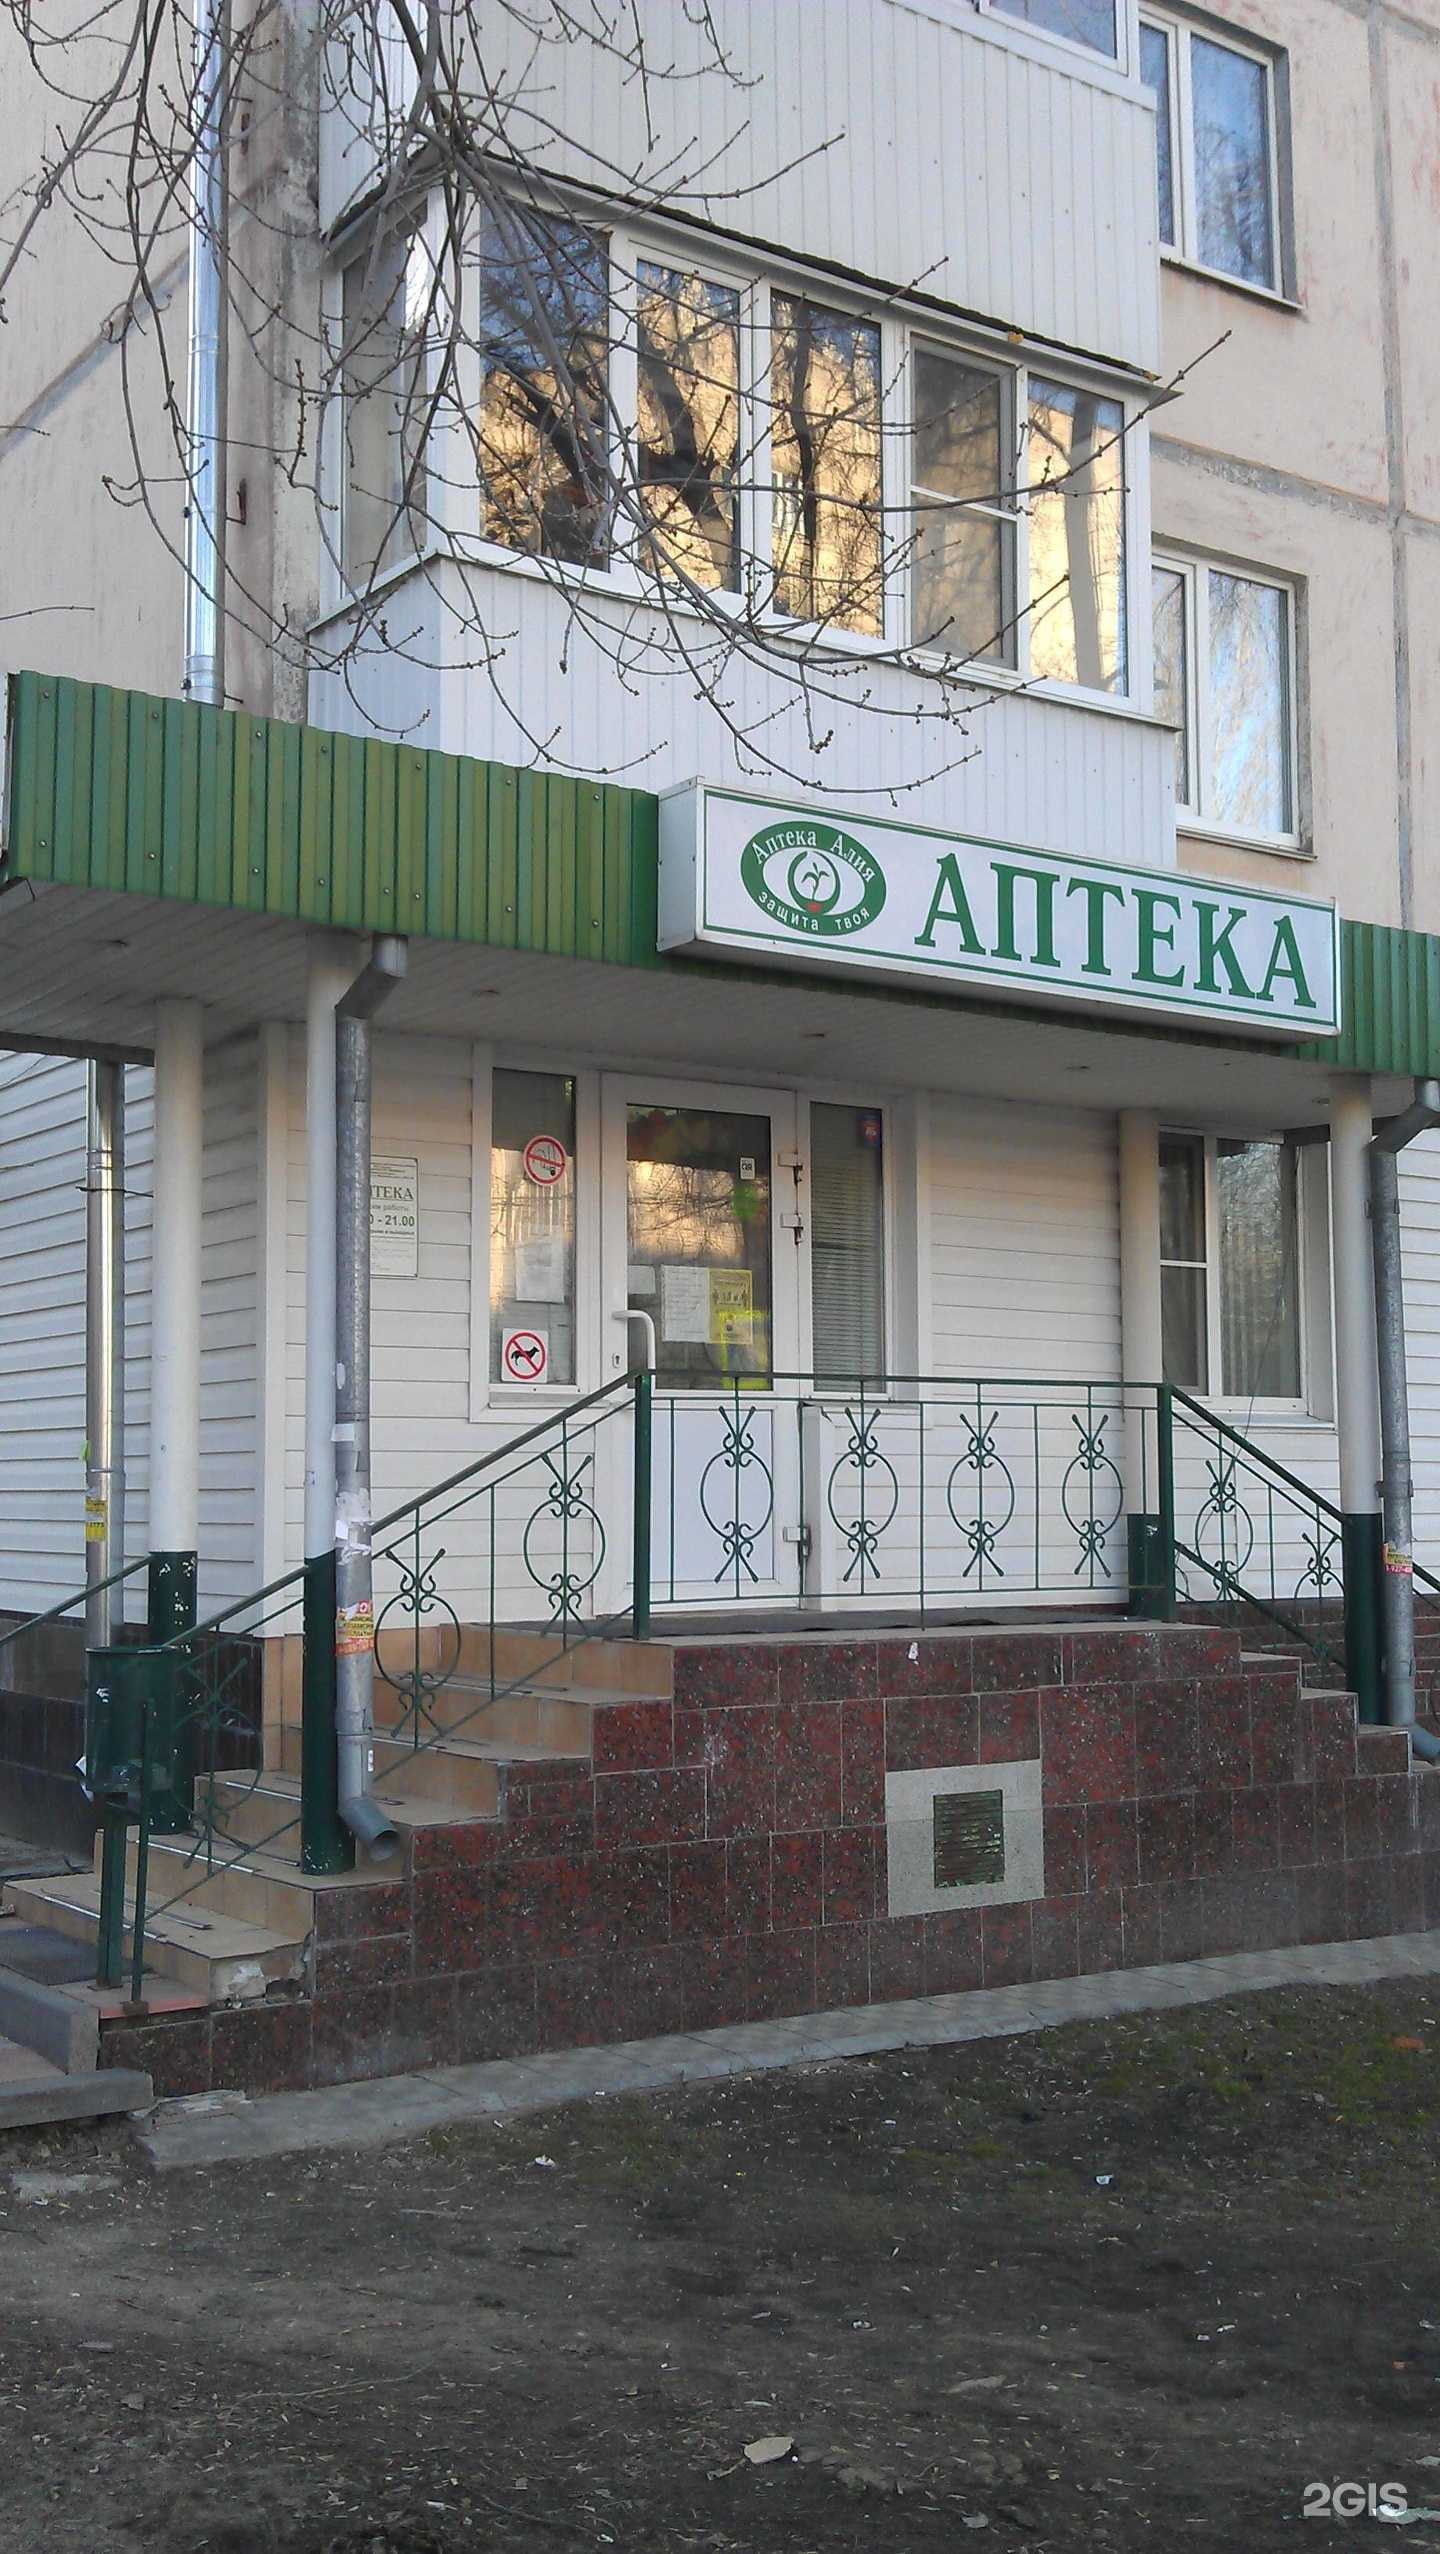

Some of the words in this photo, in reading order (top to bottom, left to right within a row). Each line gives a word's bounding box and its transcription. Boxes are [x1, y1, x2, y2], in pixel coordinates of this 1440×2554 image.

[751, 830, 817, 865] Аптека
[830, 834, 876, 883] Алия
[758, 891, 820, 931] защита
[834, 907, 871, 931] твоя
[914, 852, 1317, 1009] АПТЕКА
[370, 1185, 414, 1200] ТЕКА
